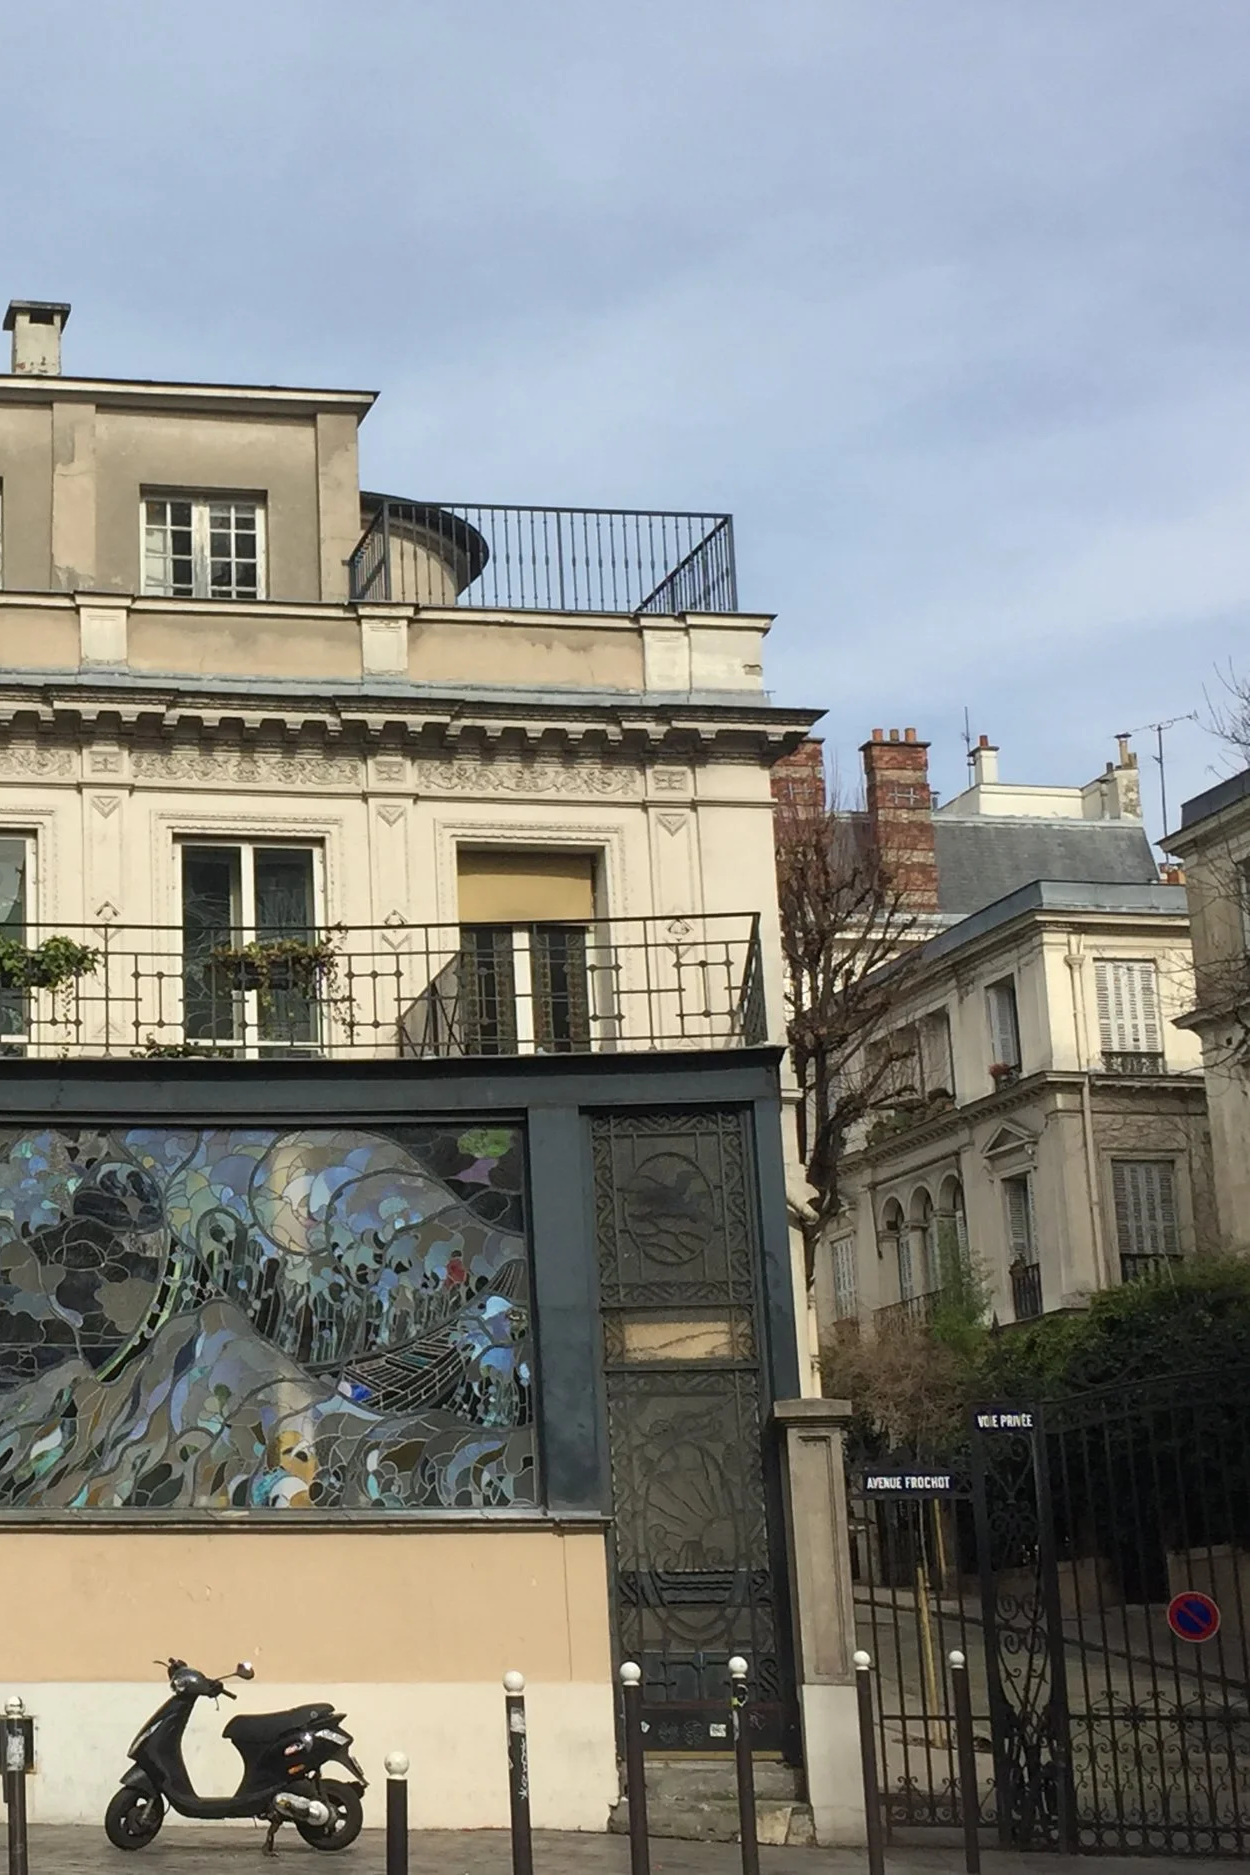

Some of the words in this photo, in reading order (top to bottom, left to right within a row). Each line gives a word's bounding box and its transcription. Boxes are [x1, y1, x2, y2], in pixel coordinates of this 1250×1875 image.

[977, 1414, 999, 1428] VOIE
[1000, 1412, 1034, 1428] PRIVÉE
[866, 1476, 902, 1490] AVENUE
[905, 1476, 950, 1489] FROCHOT
